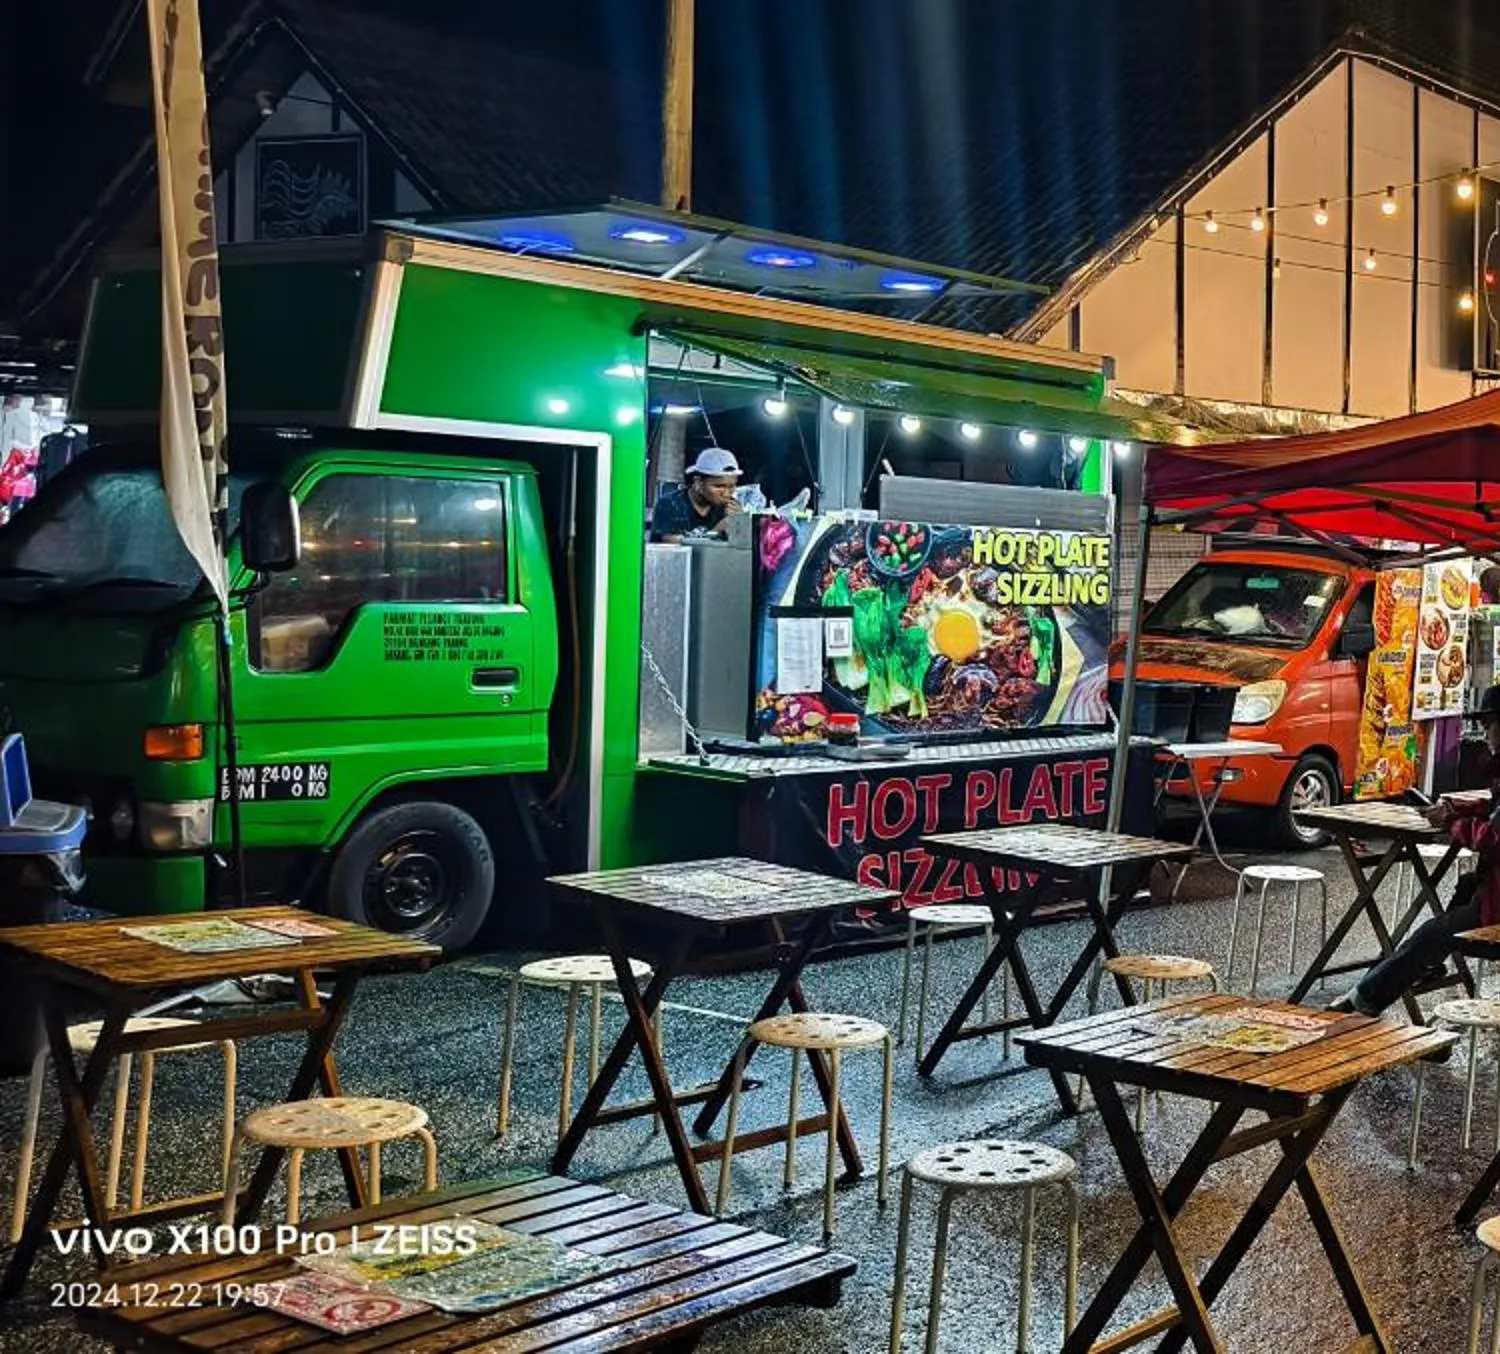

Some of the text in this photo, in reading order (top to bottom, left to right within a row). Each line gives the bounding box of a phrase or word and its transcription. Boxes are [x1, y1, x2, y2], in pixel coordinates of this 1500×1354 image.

[973, 530, 1111, 567] HOT PLATE
[997, 572, 1110, 605] SIZZLING
[261, 765, 303, 783] 2400
[308, 763, 328, 781] KG
[827, 758, 1109, 847] HOT PLATE
